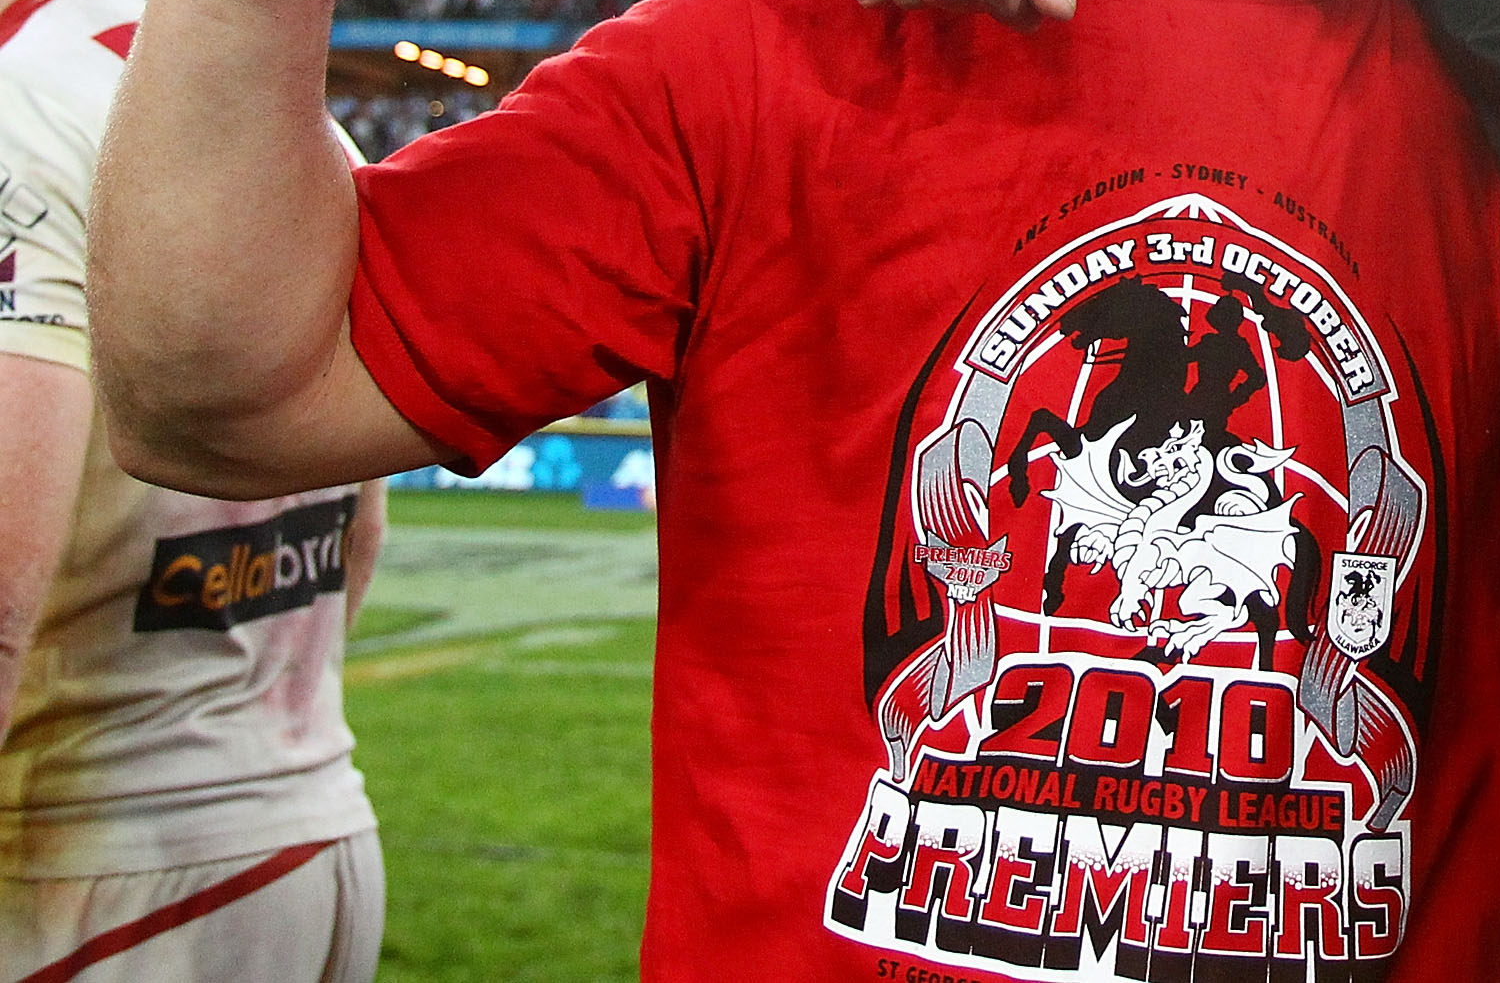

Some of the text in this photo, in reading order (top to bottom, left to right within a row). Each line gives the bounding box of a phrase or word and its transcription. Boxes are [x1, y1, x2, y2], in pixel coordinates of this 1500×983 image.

[1013, 163, 1361, 281] ANZ STADIUM SYDNEY AUSTRALIA
[979, 232, 1376, 394] SUNDAY 3rd OCTOBER
[914, 544, 1013, 572] PREMIERS
[944, 565, 987, 586] 2010
[947, 584, 976, 602] NRL
[1334, 634, 1382, 655] ILLAWARRA
[978, 662, 1294, 784] 2010
[912, 759, 1343, 832] NATIONAL RUGBY LEAGUE
[834, 780, 1406, 967] PREMIERS
